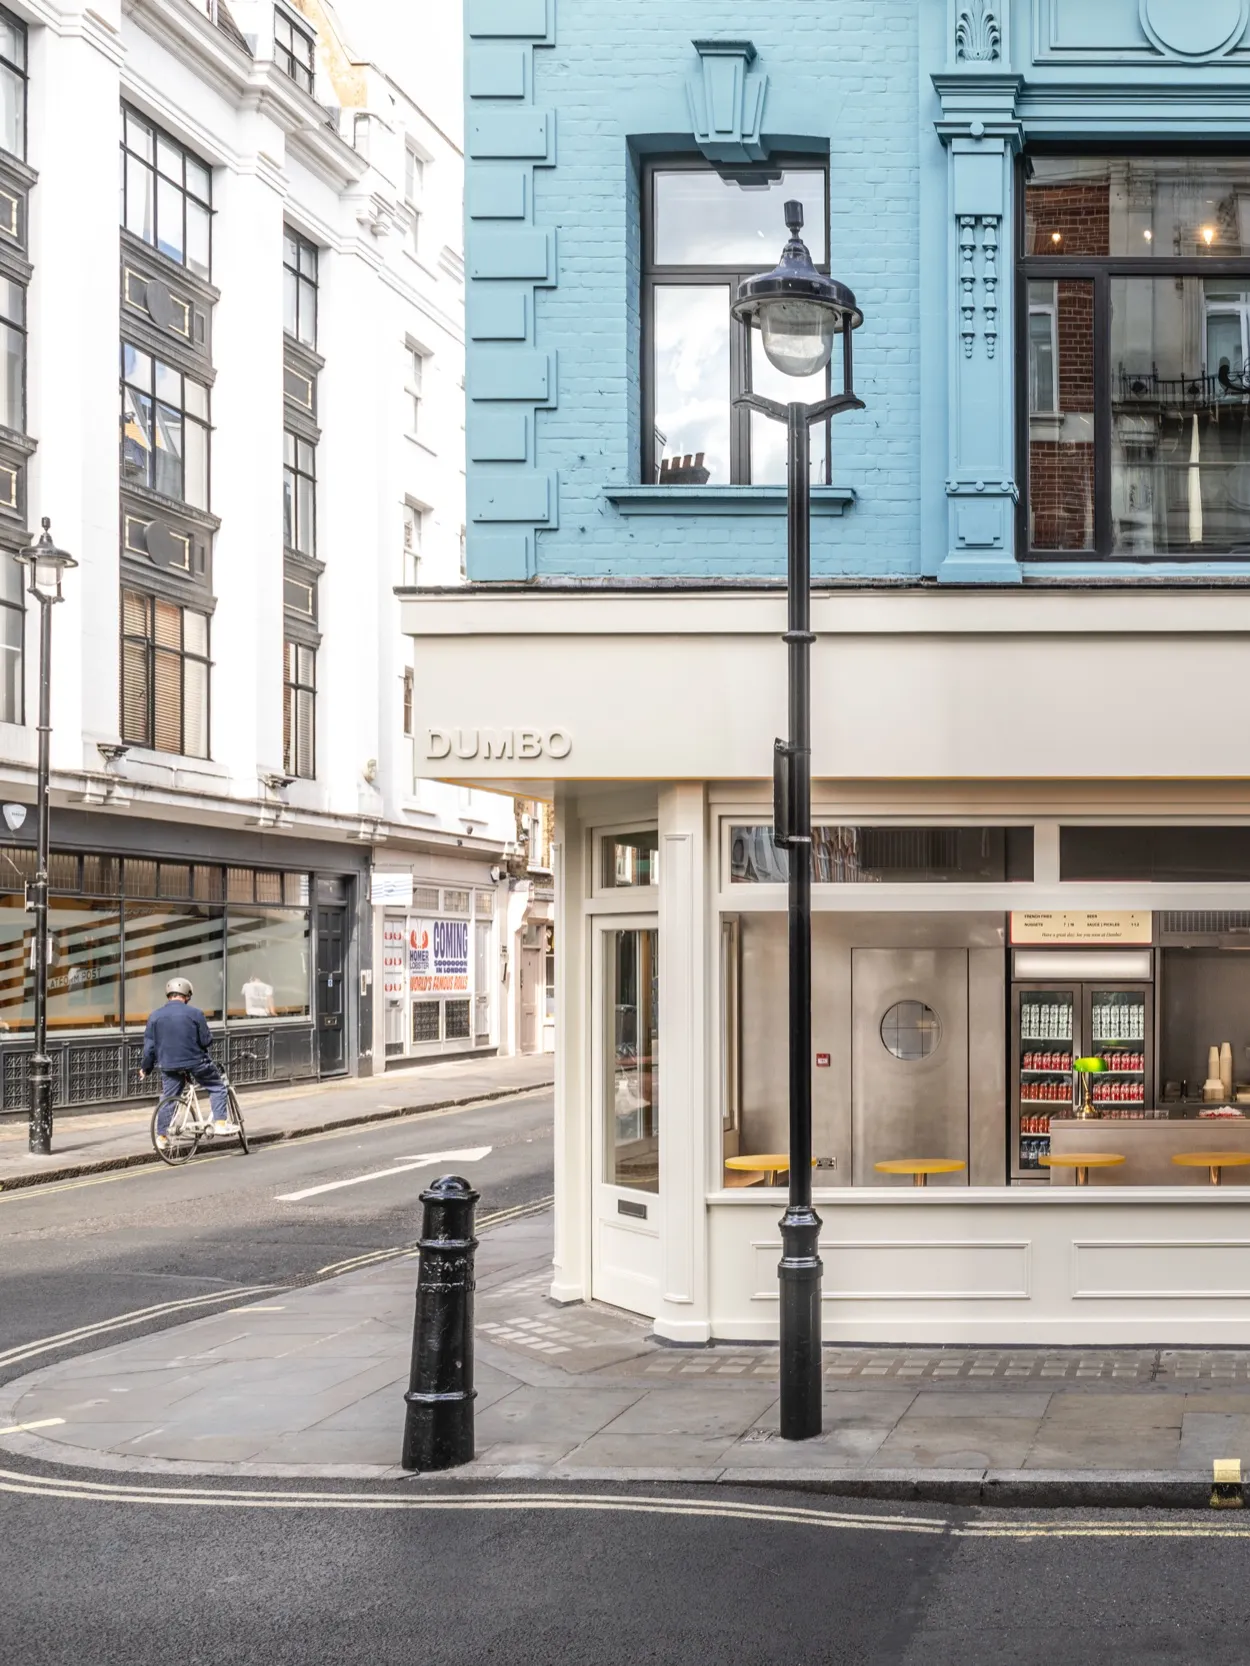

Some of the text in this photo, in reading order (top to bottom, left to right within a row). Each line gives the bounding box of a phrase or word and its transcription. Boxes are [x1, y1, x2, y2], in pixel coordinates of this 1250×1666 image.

[427, 727, 573, 760] DUMBO
[433, 921, 468, 959] COMING
[409, 950, 429, 961] HOMER
[409, 961, 429, 970] LOBSTER
[82, 968, 101, 980] POST
[409, 975, 468, 992] WORLD'S FAMOUS ROLLS
